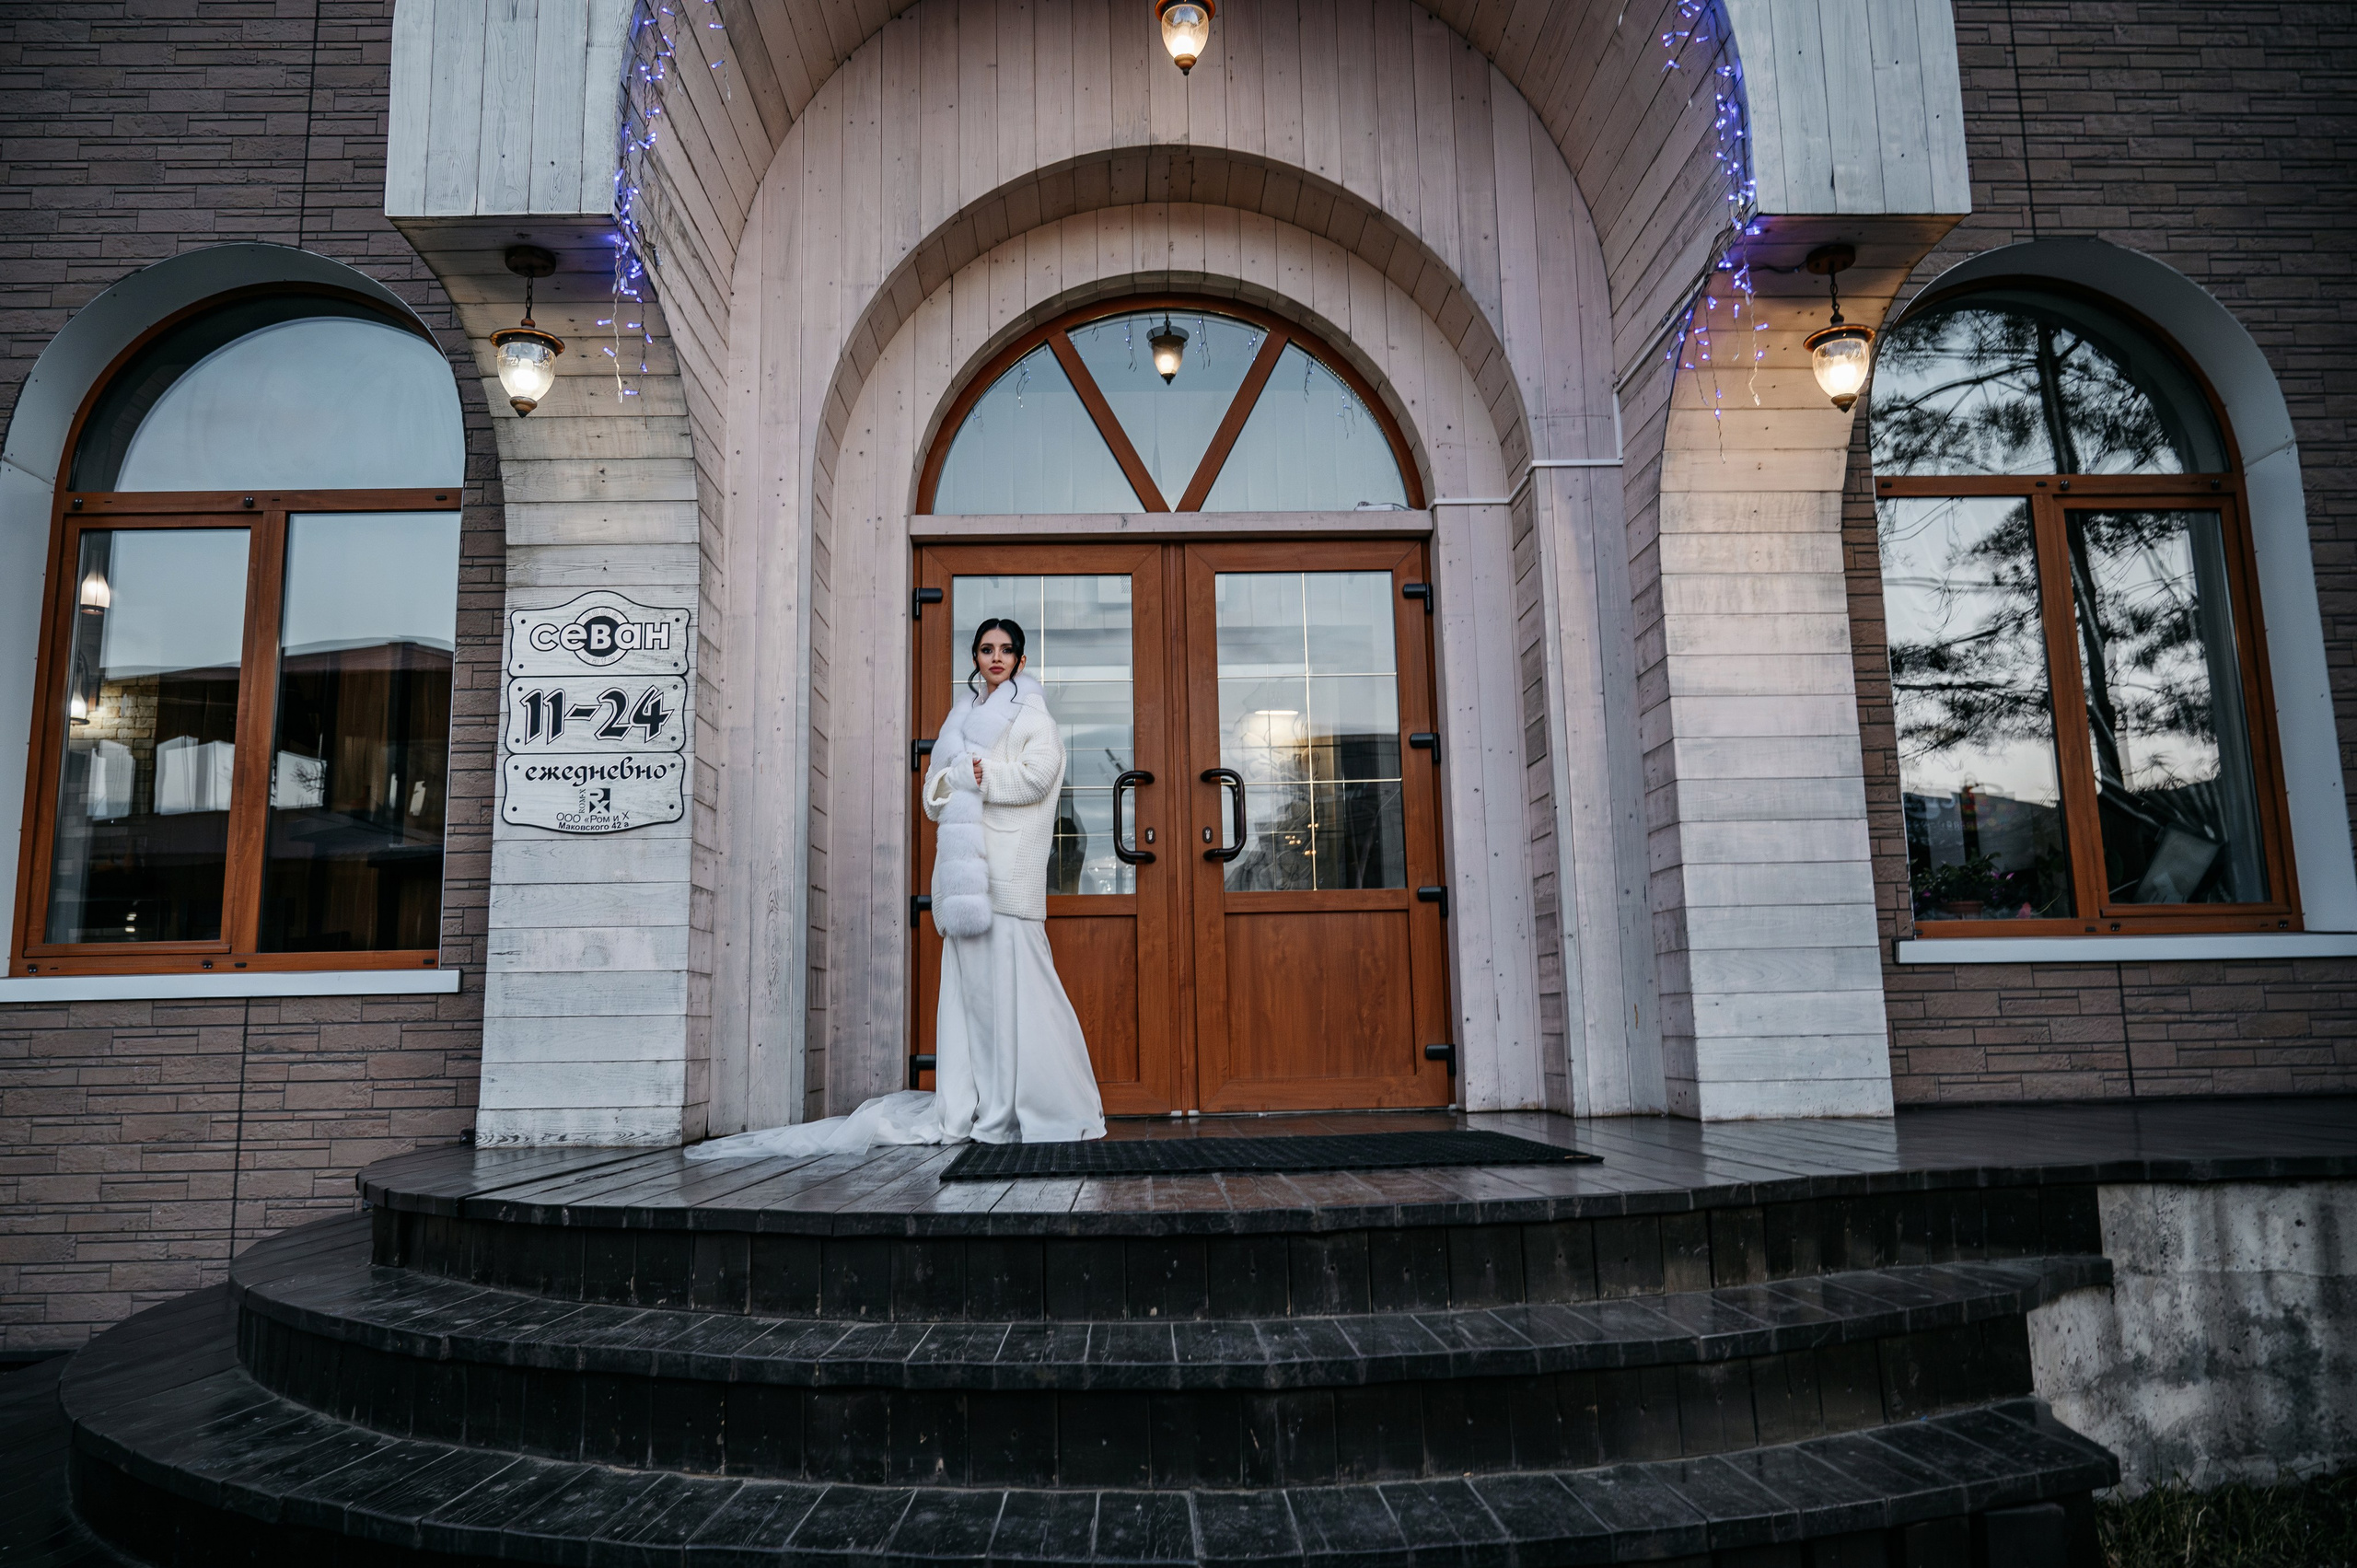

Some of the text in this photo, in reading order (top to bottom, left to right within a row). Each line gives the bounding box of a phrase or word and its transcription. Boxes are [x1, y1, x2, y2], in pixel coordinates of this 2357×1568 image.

[519, 684, 675, 746] 11-24
[525, 756, 668, 787] ежедневно
[556, 812, 581, 823] ООО
[558, 822, 609, 830] Маковского
